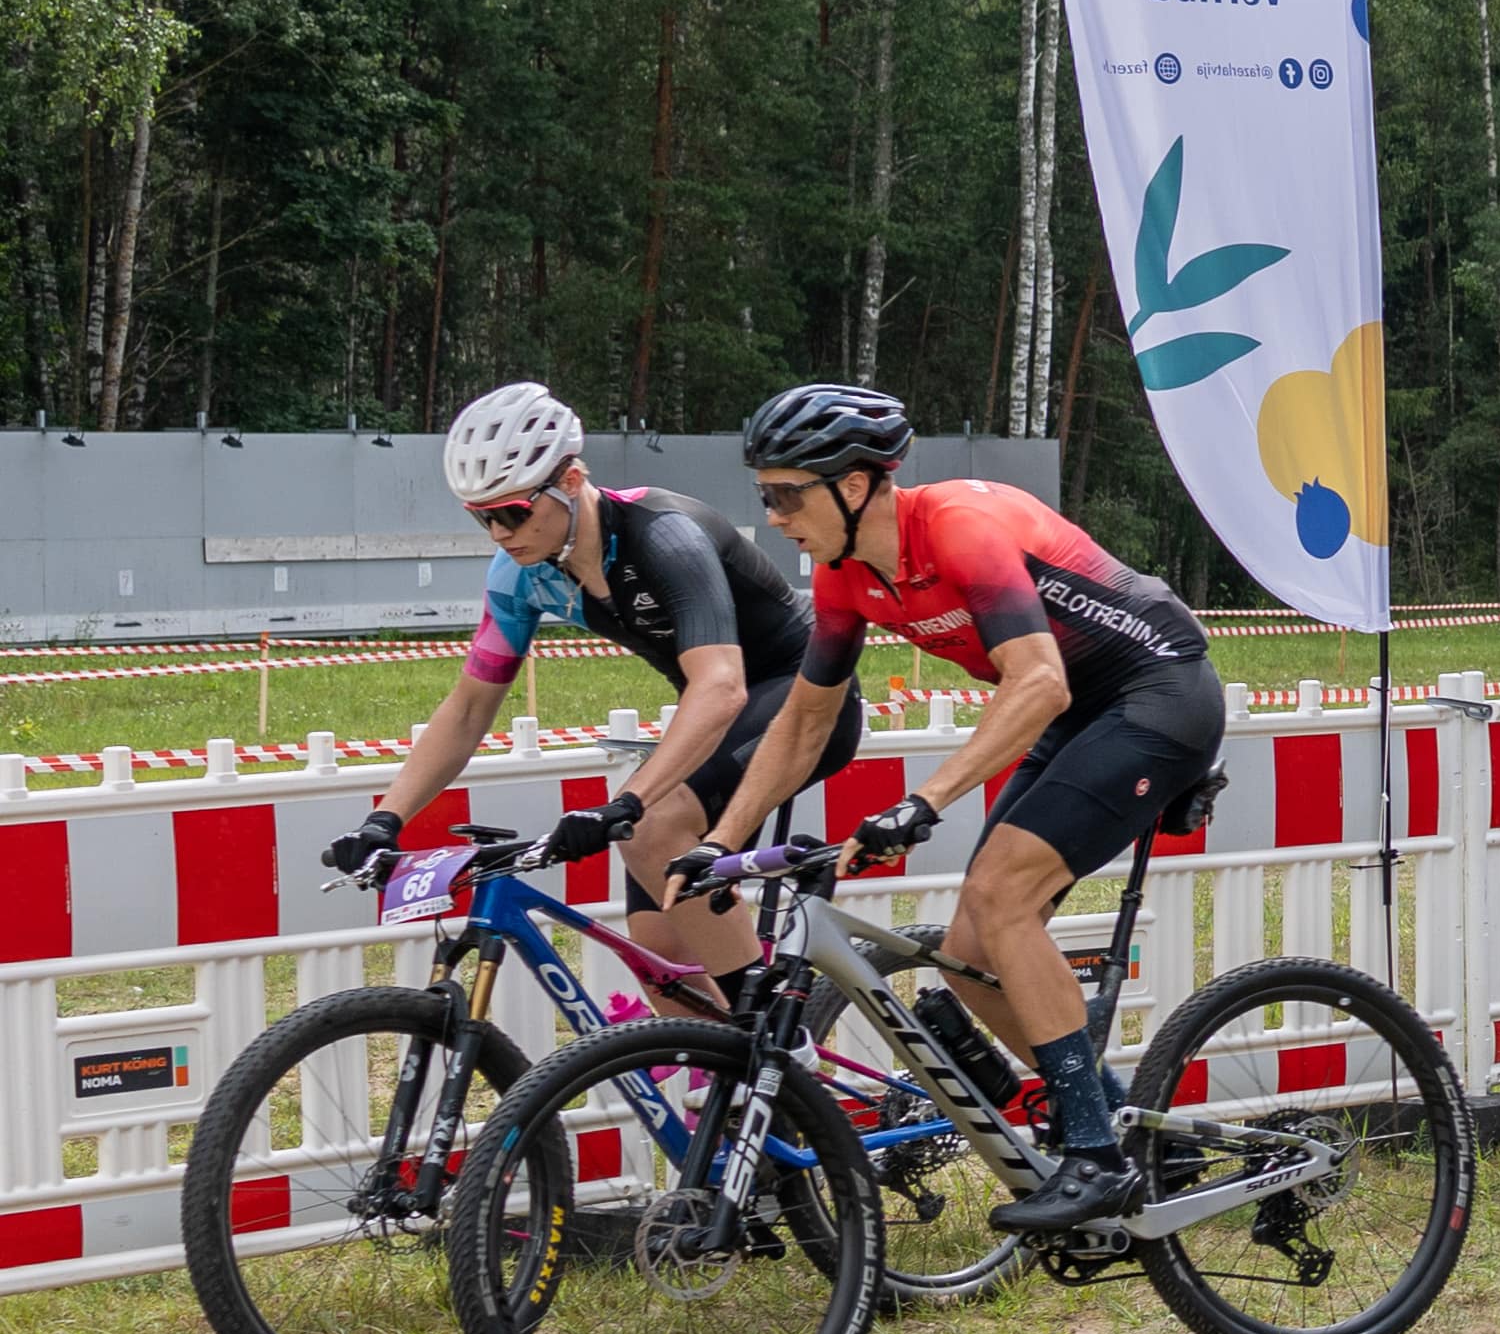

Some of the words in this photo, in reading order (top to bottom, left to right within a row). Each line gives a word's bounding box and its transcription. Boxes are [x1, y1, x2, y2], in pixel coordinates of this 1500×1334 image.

[401, 870, 437, 902] 68
[81, 1061, 121, 1077] KURT
[122, 1055, 168, 1073] KÖNIG
[82, 1074, 123, 1090] NOMA
[1244, 1168, 1306, 1194] SCOTT
[528, 1203, 566, 1306] MAXXIS
